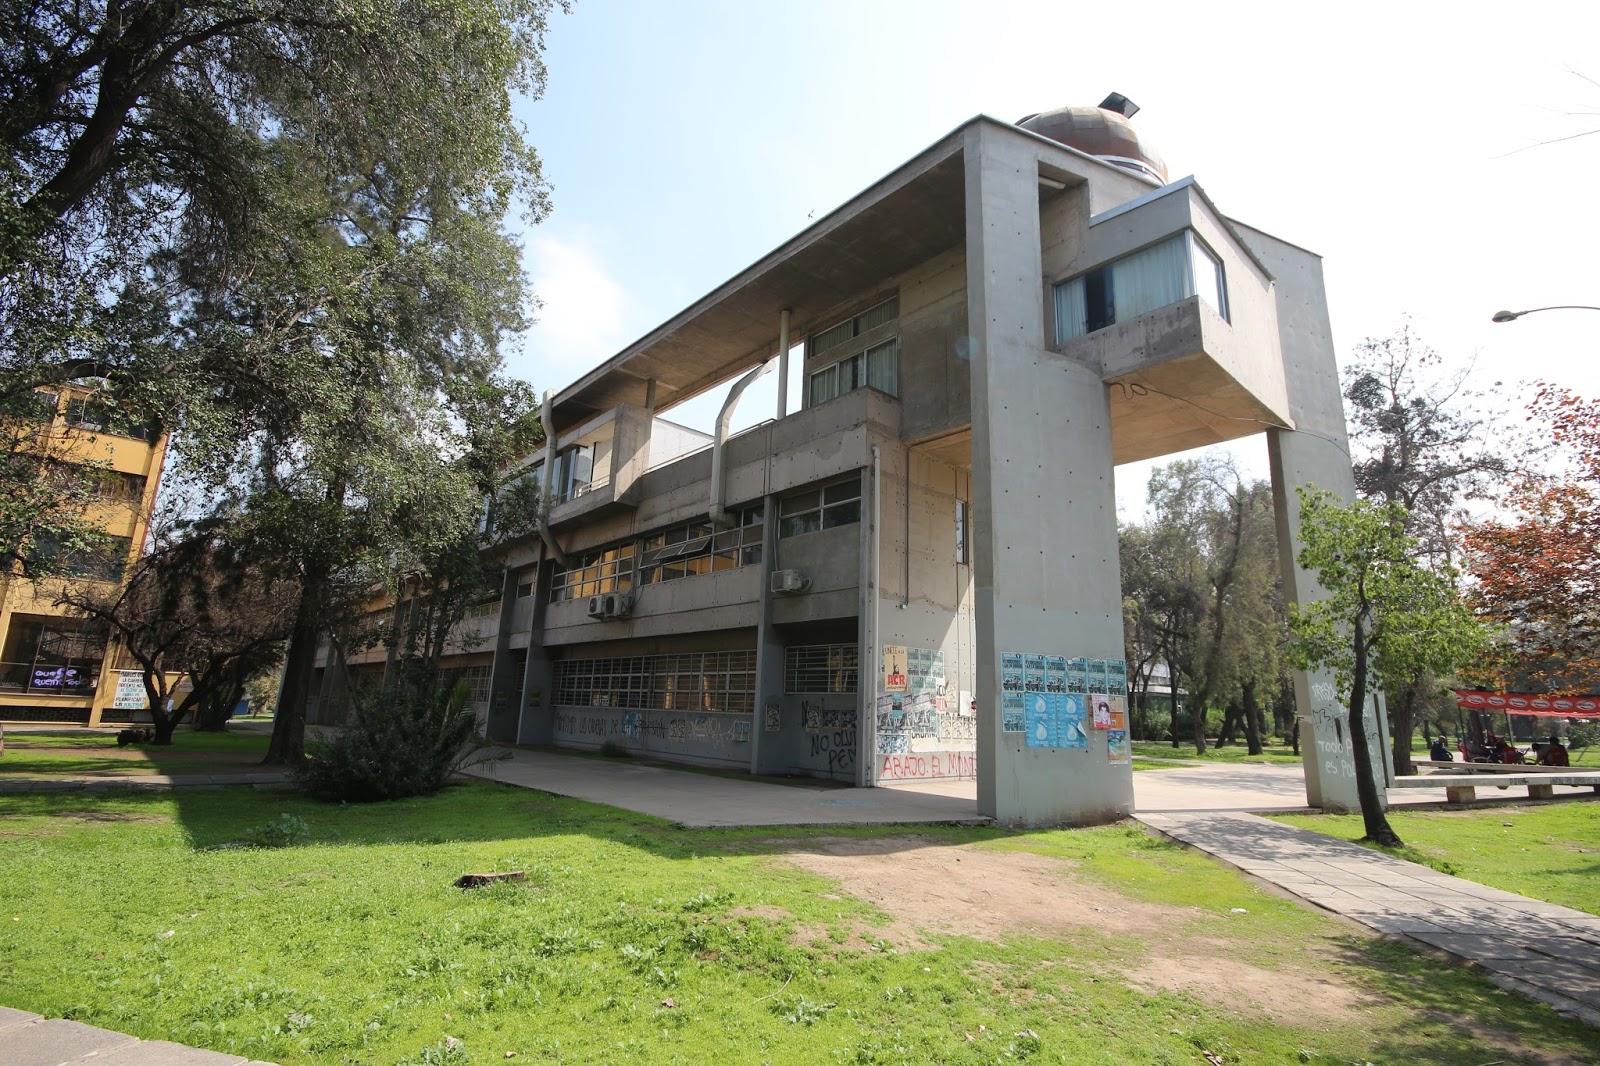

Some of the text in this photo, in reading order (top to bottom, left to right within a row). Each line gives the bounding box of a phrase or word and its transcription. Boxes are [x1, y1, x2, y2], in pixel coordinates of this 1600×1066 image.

[887, 674, 906, 685] ACR
[811, 734, 829, 757] NO
[883, 756, 925, 779] ABAJO
[932, 754, 944, 777] EL
